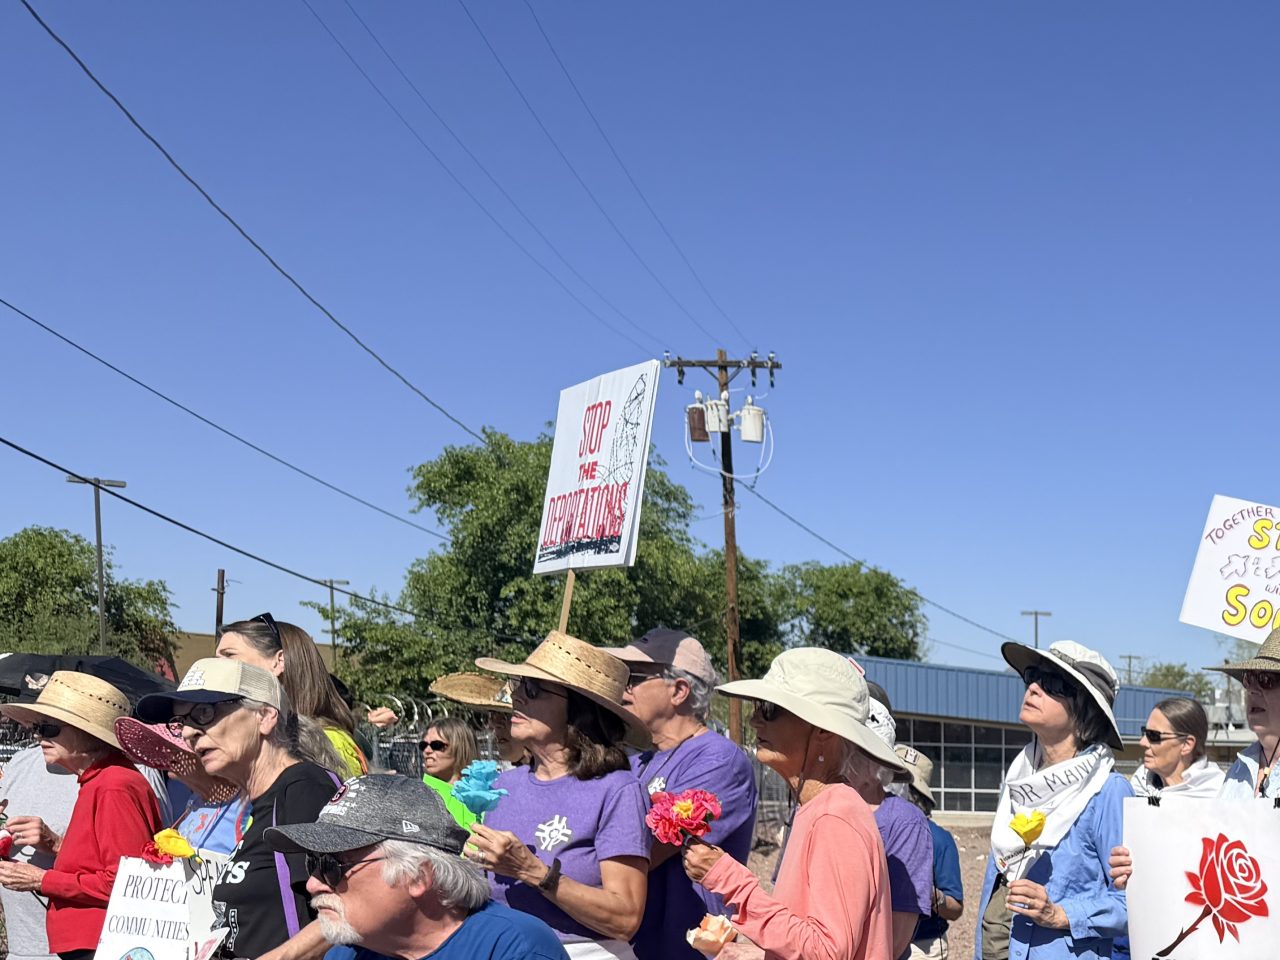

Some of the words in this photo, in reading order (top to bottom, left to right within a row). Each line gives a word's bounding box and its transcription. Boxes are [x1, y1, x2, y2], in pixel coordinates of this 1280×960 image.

[579, 400, 612, 458] STOP
[578, 461, 599, 481] THE
[543, 481, 628, 546] DEPORTATIONS
[1204, 505, 1275, 545] TOGETHER
